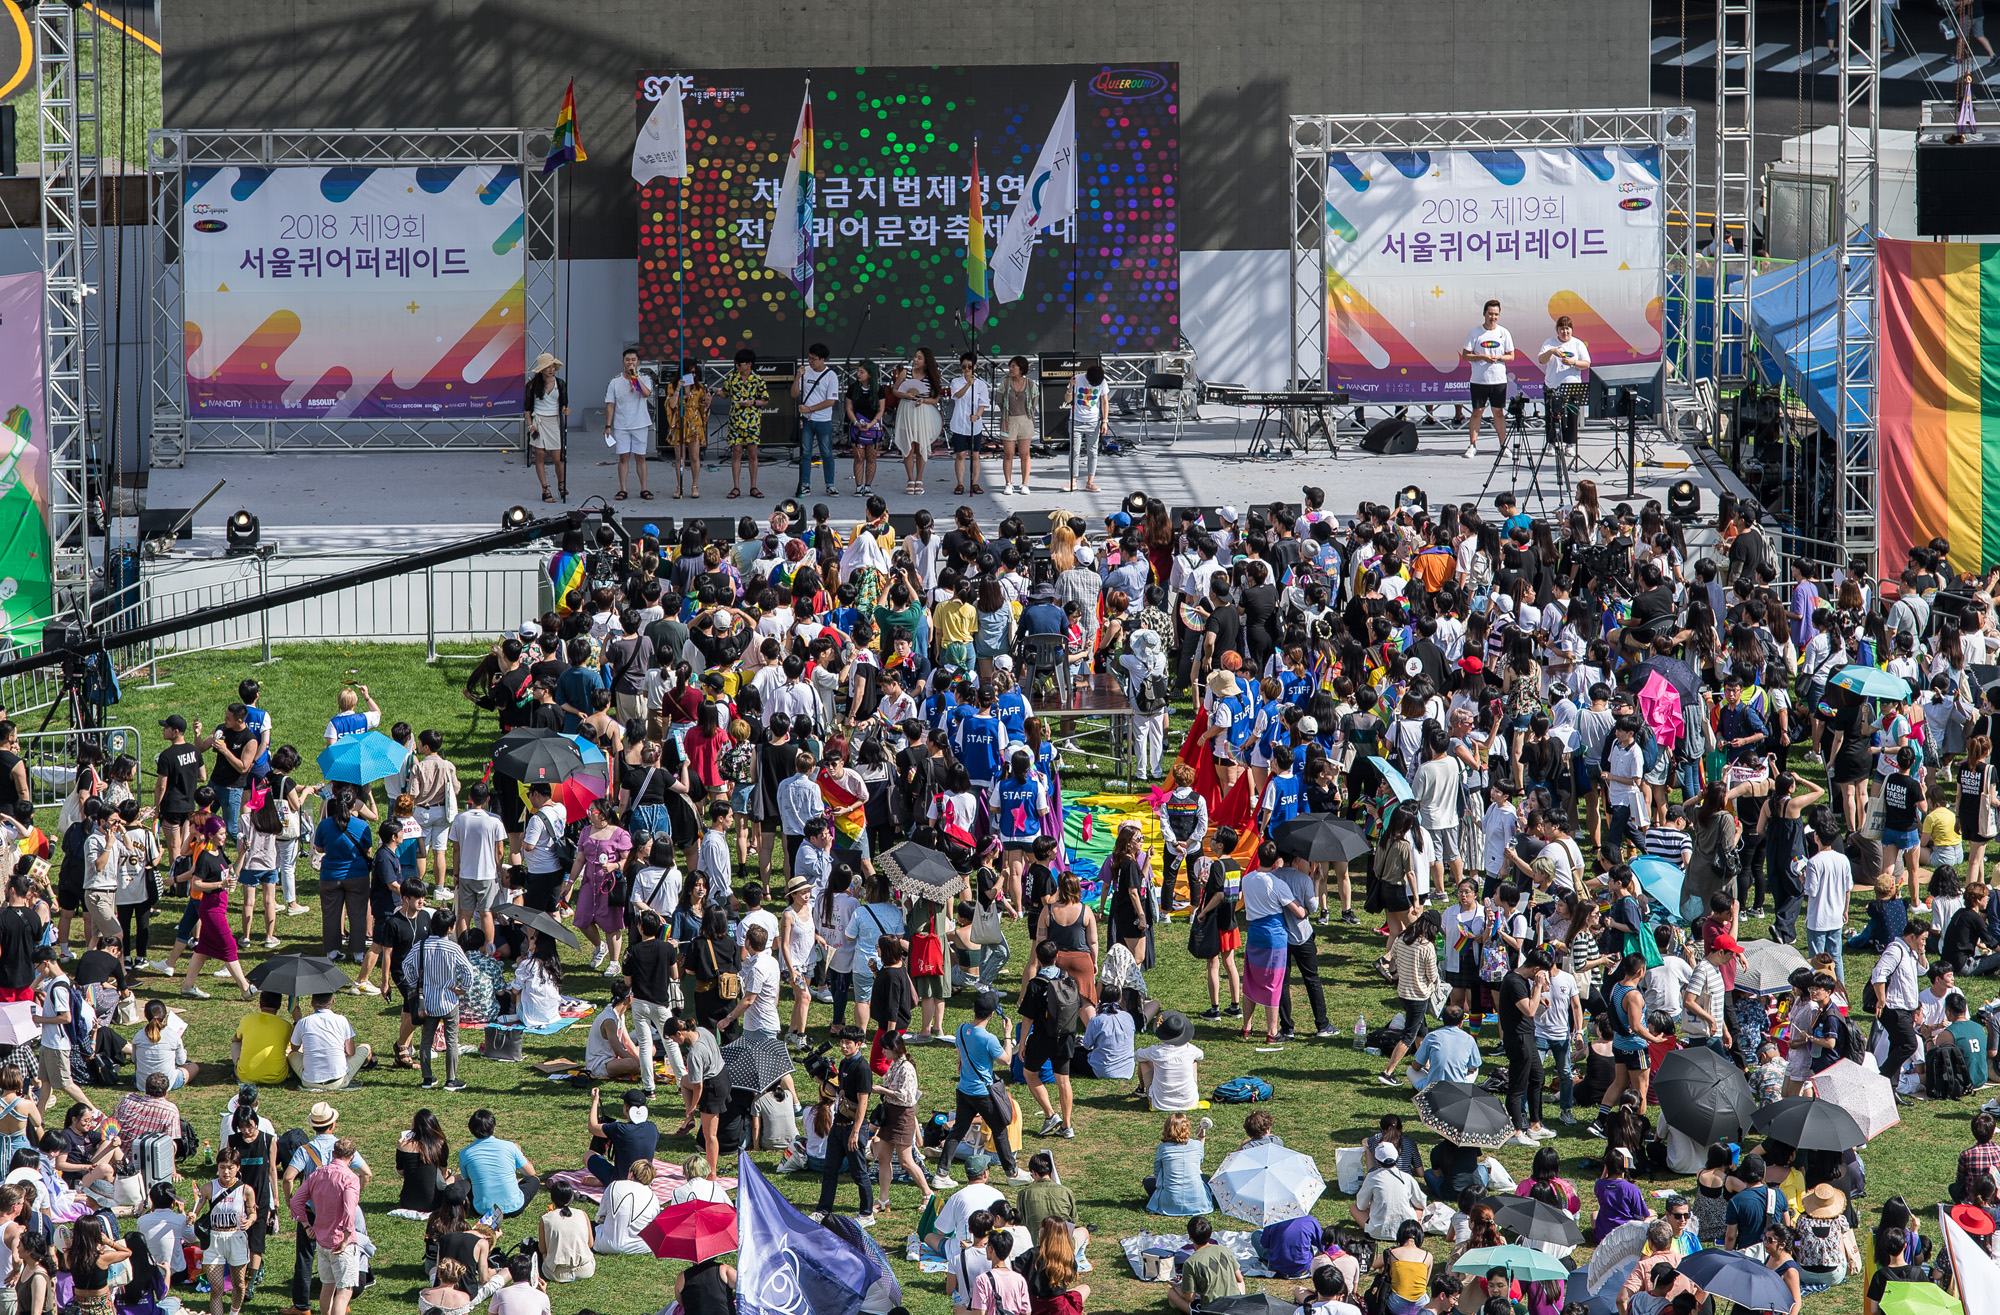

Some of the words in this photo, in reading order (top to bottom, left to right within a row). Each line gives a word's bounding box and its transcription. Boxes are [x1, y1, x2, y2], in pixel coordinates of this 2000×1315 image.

[1422, 198, 1479, 224] 2018
[1490, 195, 1564, 226] 제19회
[280, 214, 337, 239] 2018
[350, 213, 425, 243] 제19회
[736, 215, 1078, 248] 전퀴어문화축제대
[1381, 227, 1608, 264] 서울퀴어퍼레이드
[239, 246, 470, 279] 서울퀴어퍼레이드
[1289, 686, 1311, 695] STAFF
[991, 706, 1020, 718] STAFF
[966, 734, 993, 745] STAFF
[1961, 769, 1981, 780] LUSH
[1886, 782, 1907, 794] LUSH
[1961, 777, 1980, 787] FRESH
[1003, 791, 1033, 800] STAFF
[1281, 794, 1298, 806] STAF
[1886, 790, 1906, 801] FRESH
[1969, 1038, 1981, 1053] 13
